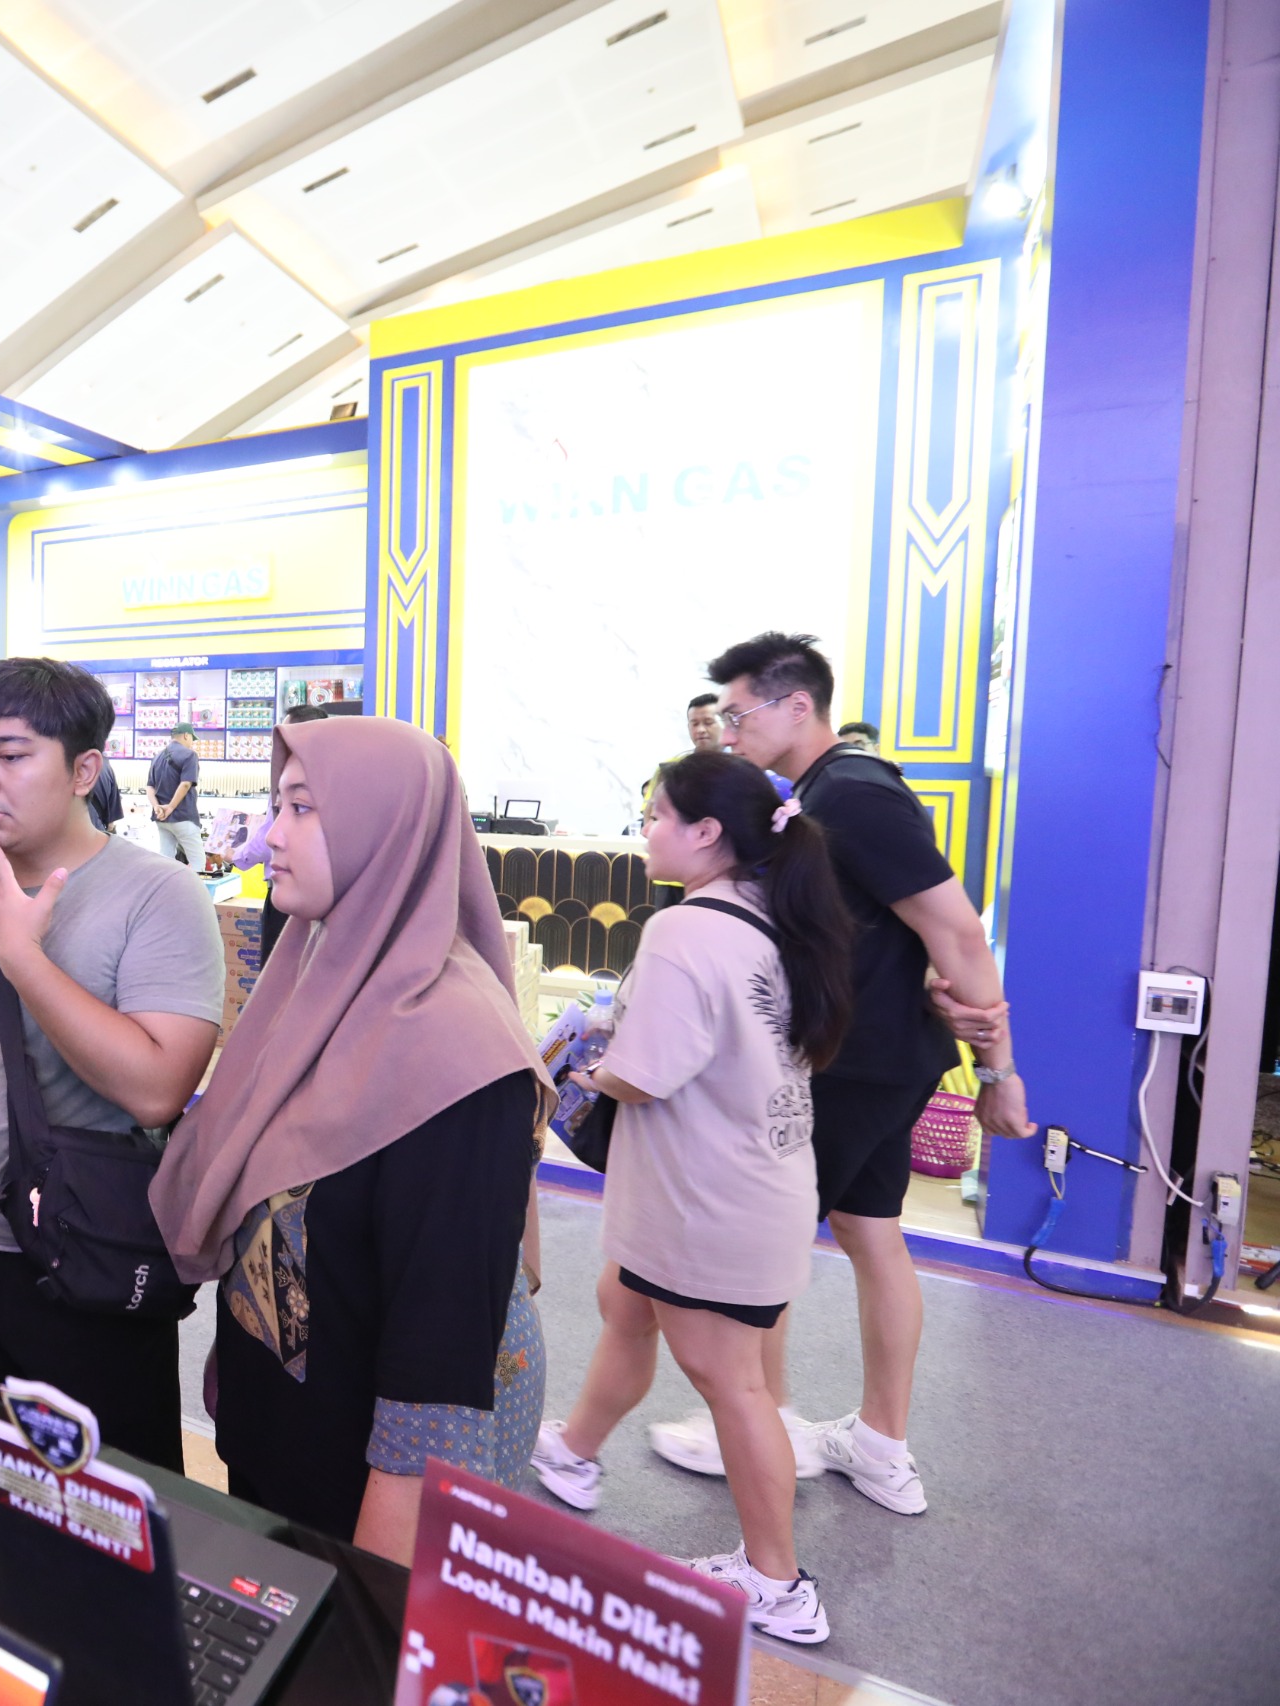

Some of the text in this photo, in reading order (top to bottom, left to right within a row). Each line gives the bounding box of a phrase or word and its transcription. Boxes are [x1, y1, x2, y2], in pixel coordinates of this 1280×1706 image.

[672, 453, 813, 508] GAS
[122, 567, 265, 603] WINN GAS
[150, 656, 209, 668] REGULATOR
[125, 1264, 150, 1310] torch
[9, 1491, 63, 1528] KAMI
[66, 1520, 132, 1561] GANTI
[448, 1521, 704, 1669] Nambah Dikit
[440, 1557, 702, 1706] Looks Makin Naik!
